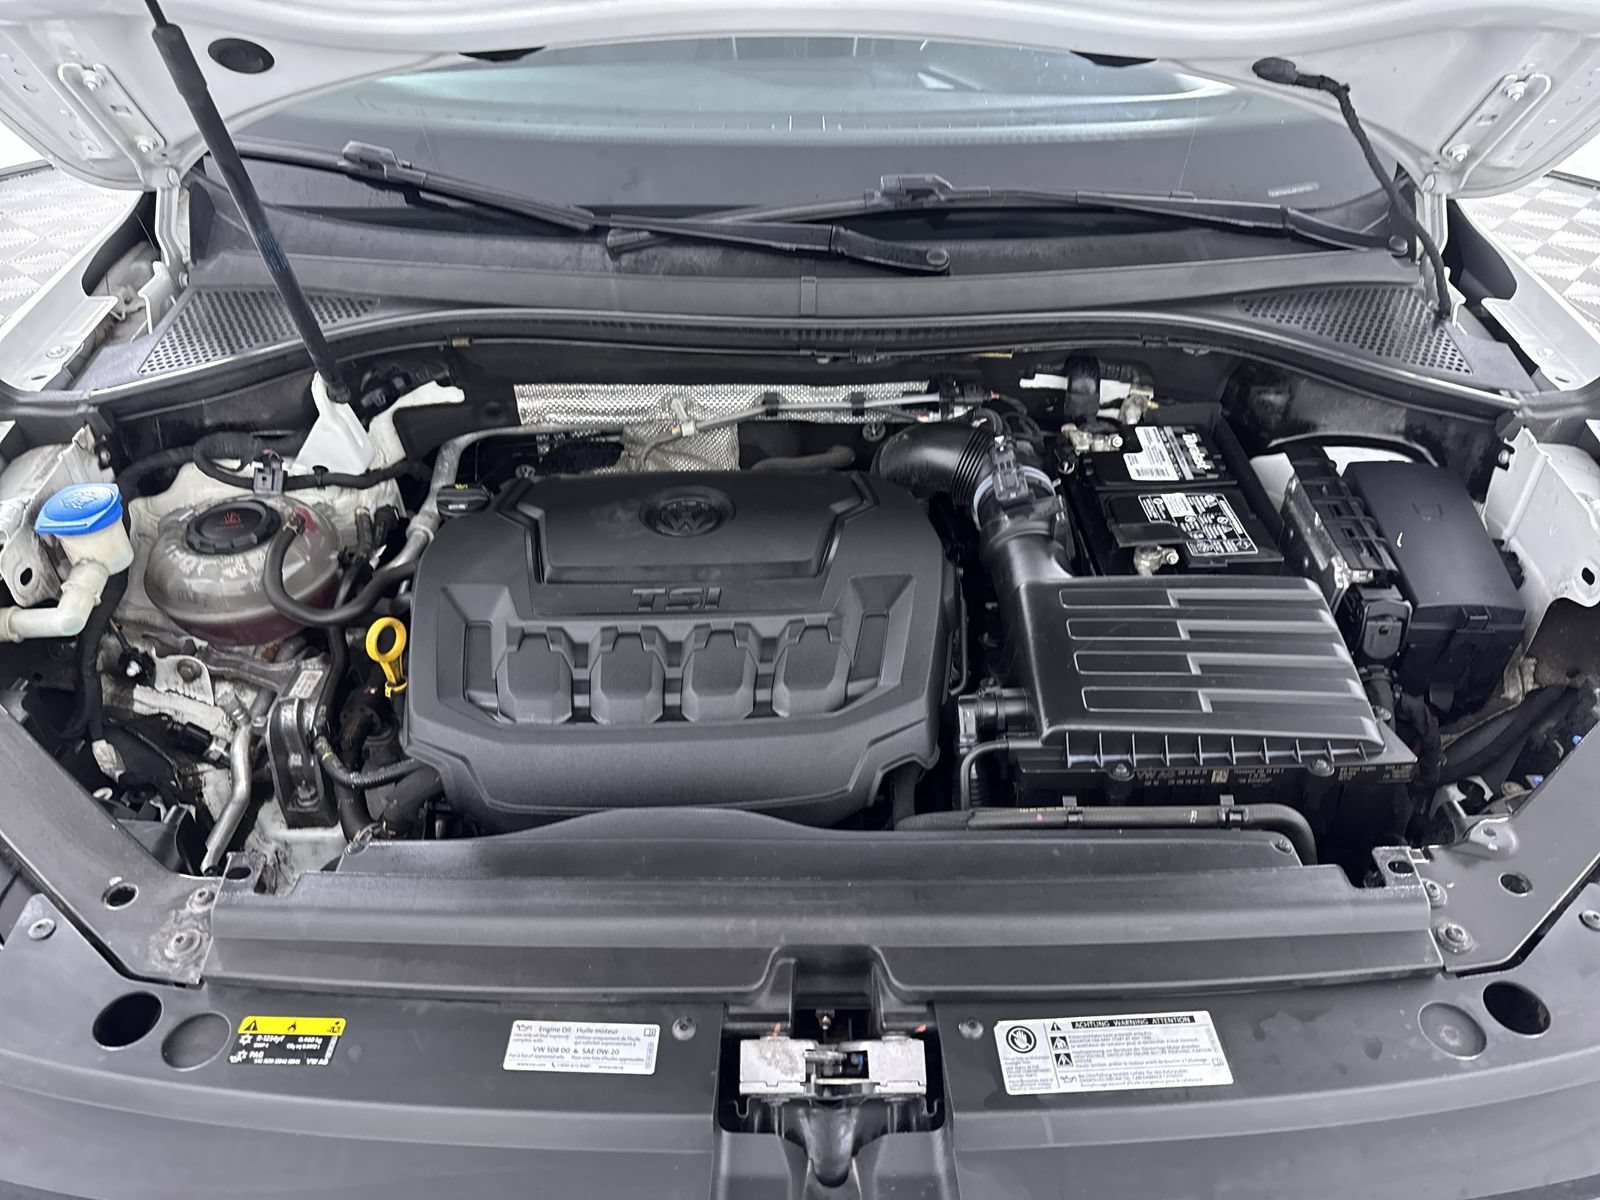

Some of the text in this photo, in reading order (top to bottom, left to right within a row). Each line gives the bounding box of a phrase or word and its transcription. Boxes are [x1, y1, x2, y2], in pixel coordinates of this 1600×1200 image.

[632, 586, 722, 612] TSI
[1075, 1016, 1191, 1029] ACHTUNG WARNING ATTENTION
[539, 1026, 561, 1034] Engine
[596, 1048, 620, 1056] 0W-20
